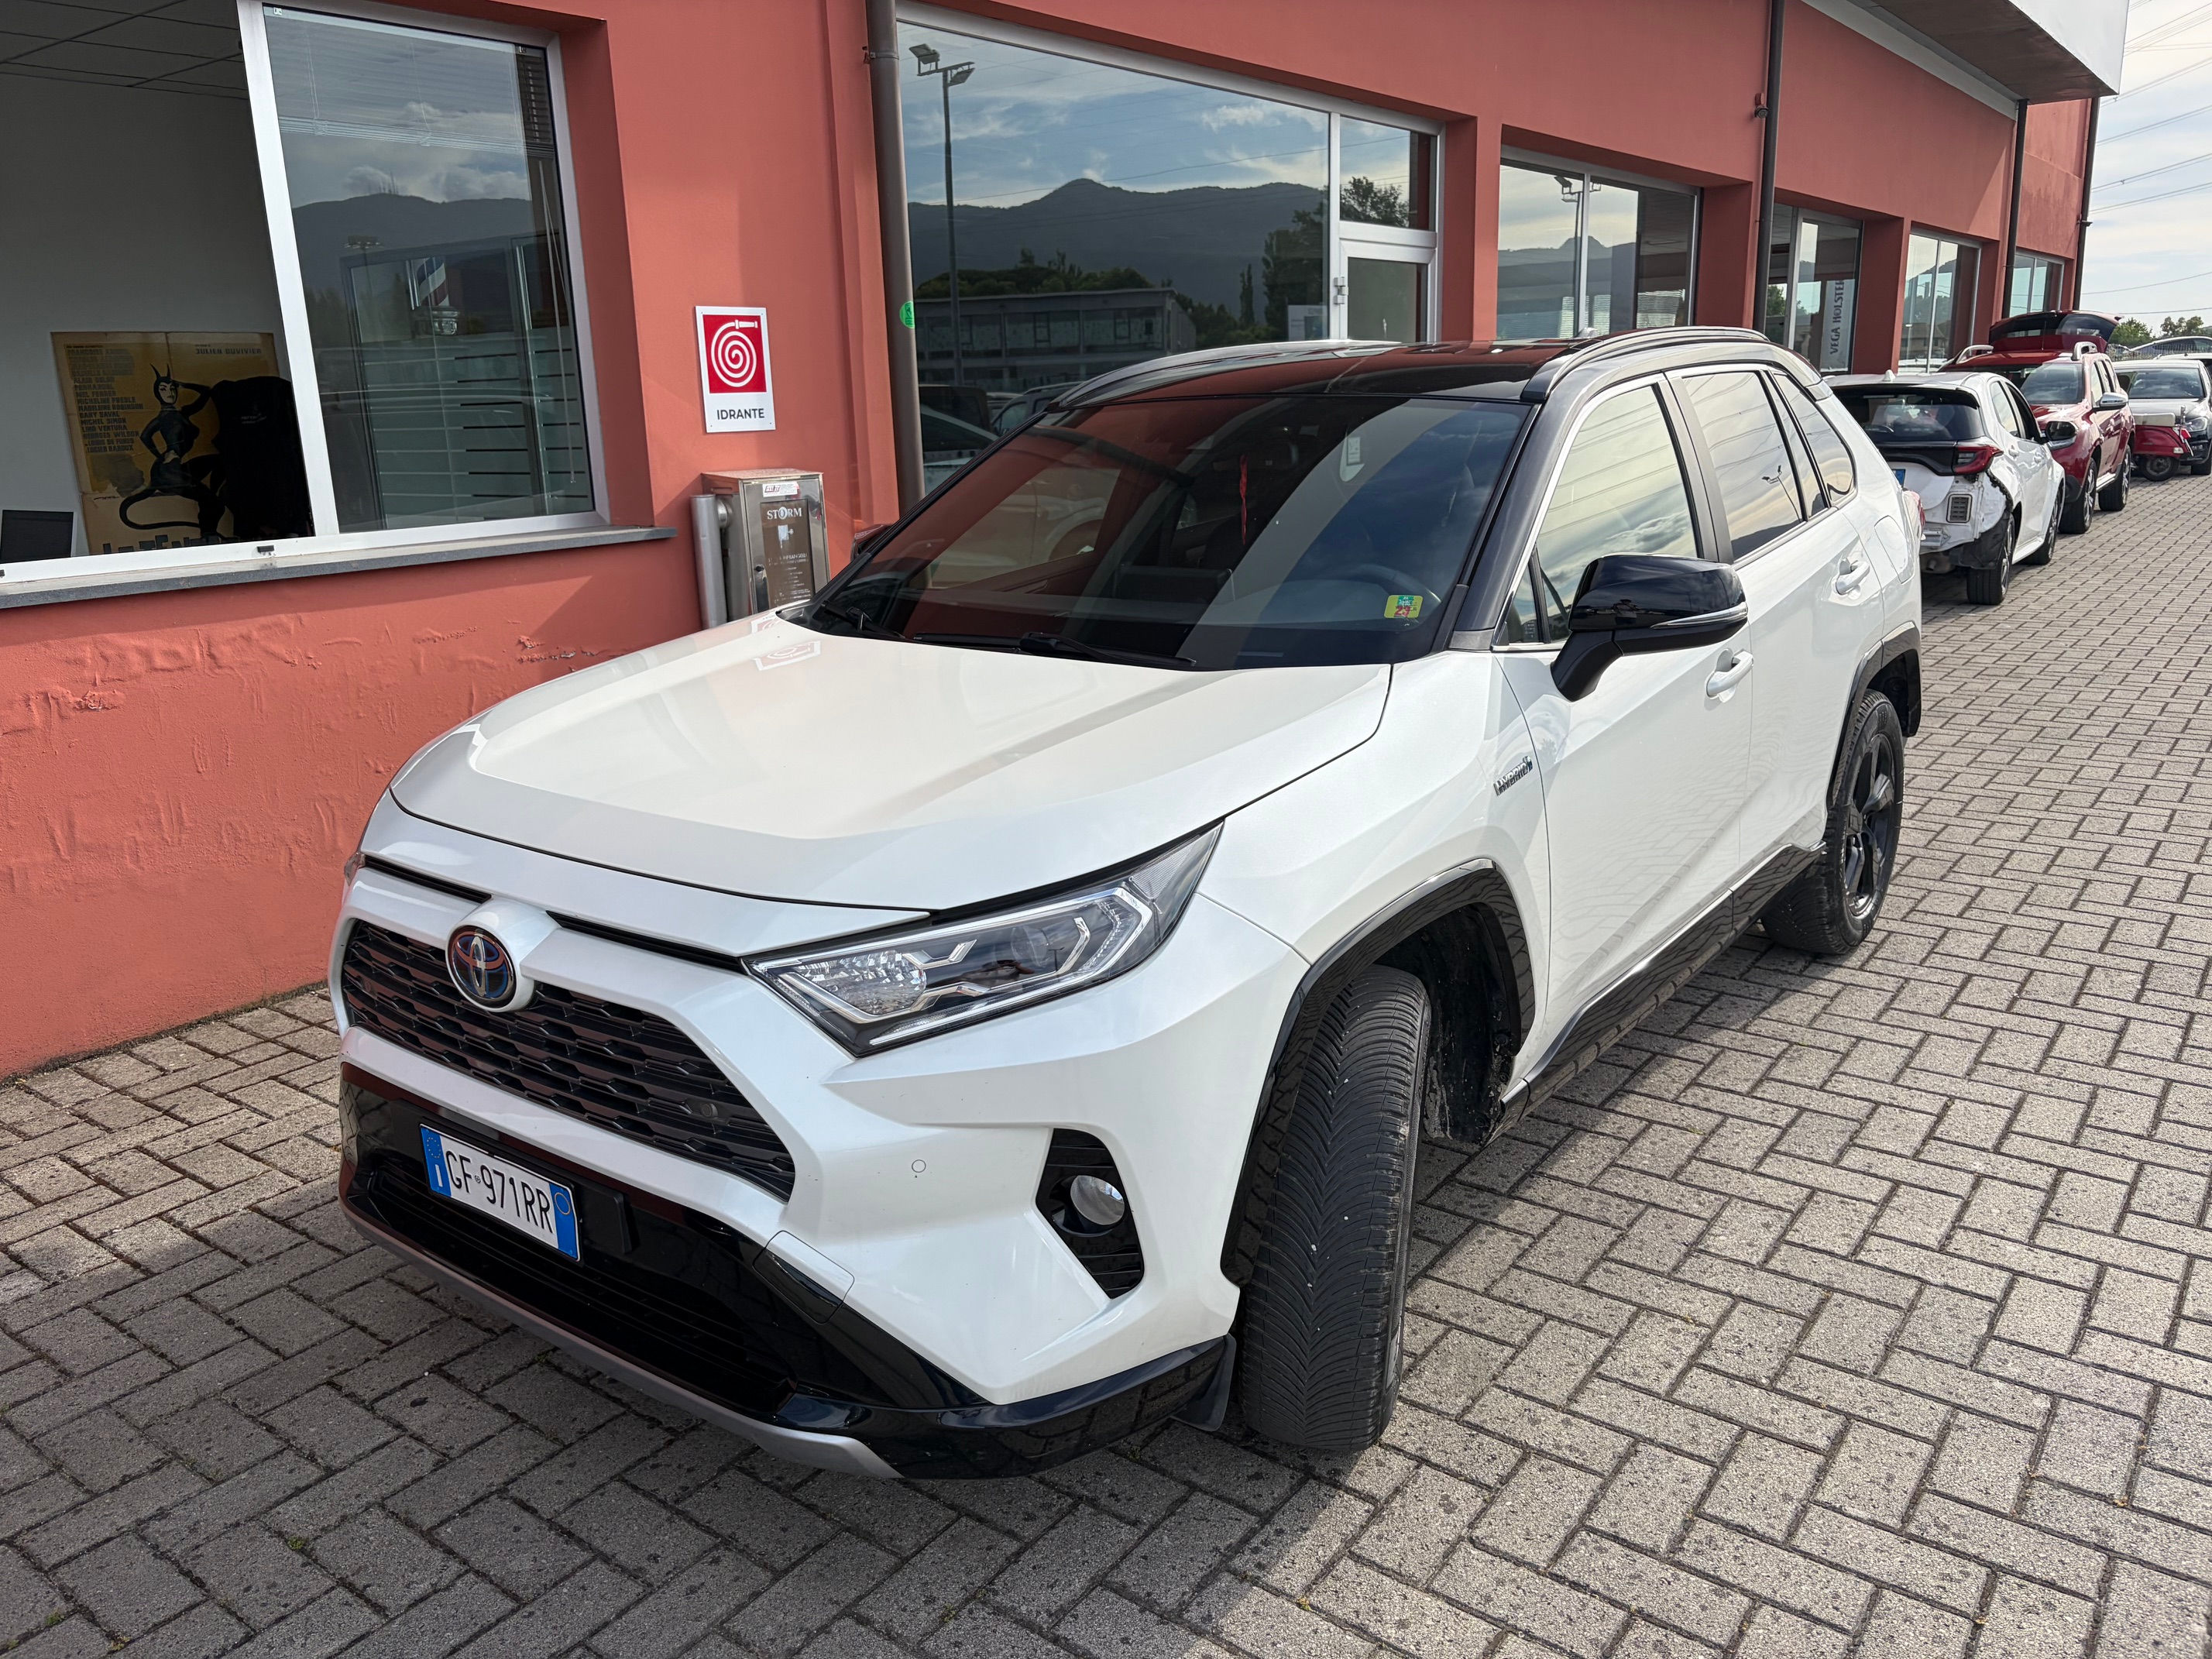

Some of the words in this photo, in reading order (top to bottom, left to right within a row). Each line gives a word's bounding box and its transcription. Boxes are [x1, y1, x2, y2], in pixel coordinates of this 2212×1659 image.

[1830, 327, 1840, 355] VEGA
[716, 408, 765, 420] IDRANTE
[767, 507, 802, 520] STORM
